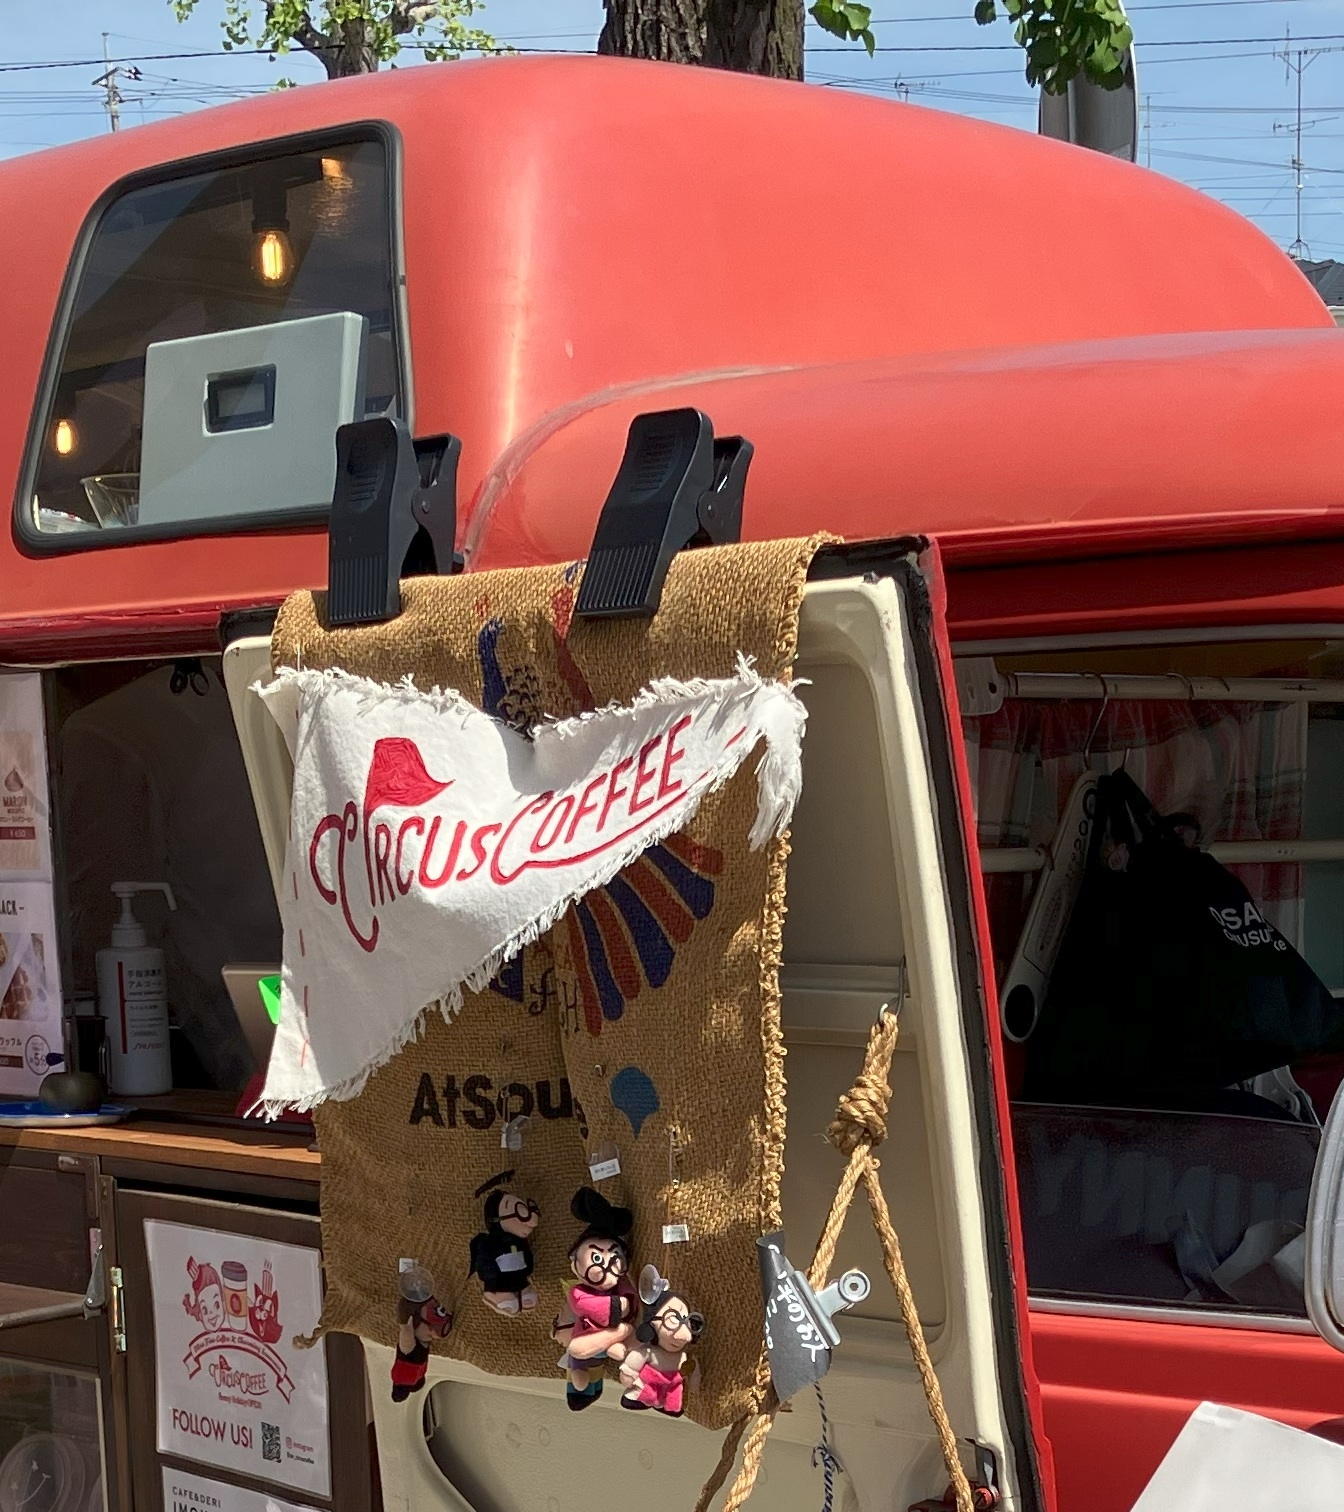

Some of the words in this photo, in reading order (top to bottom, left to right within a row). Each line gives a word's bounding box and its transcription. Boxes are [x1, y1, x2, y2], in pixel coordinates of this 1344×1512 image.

[172, 1408, 226, 1442] FOLLOW
[231, 1423, 253, 1449] US!
[172, 1486, 221, 1508] CAFE&DERI
